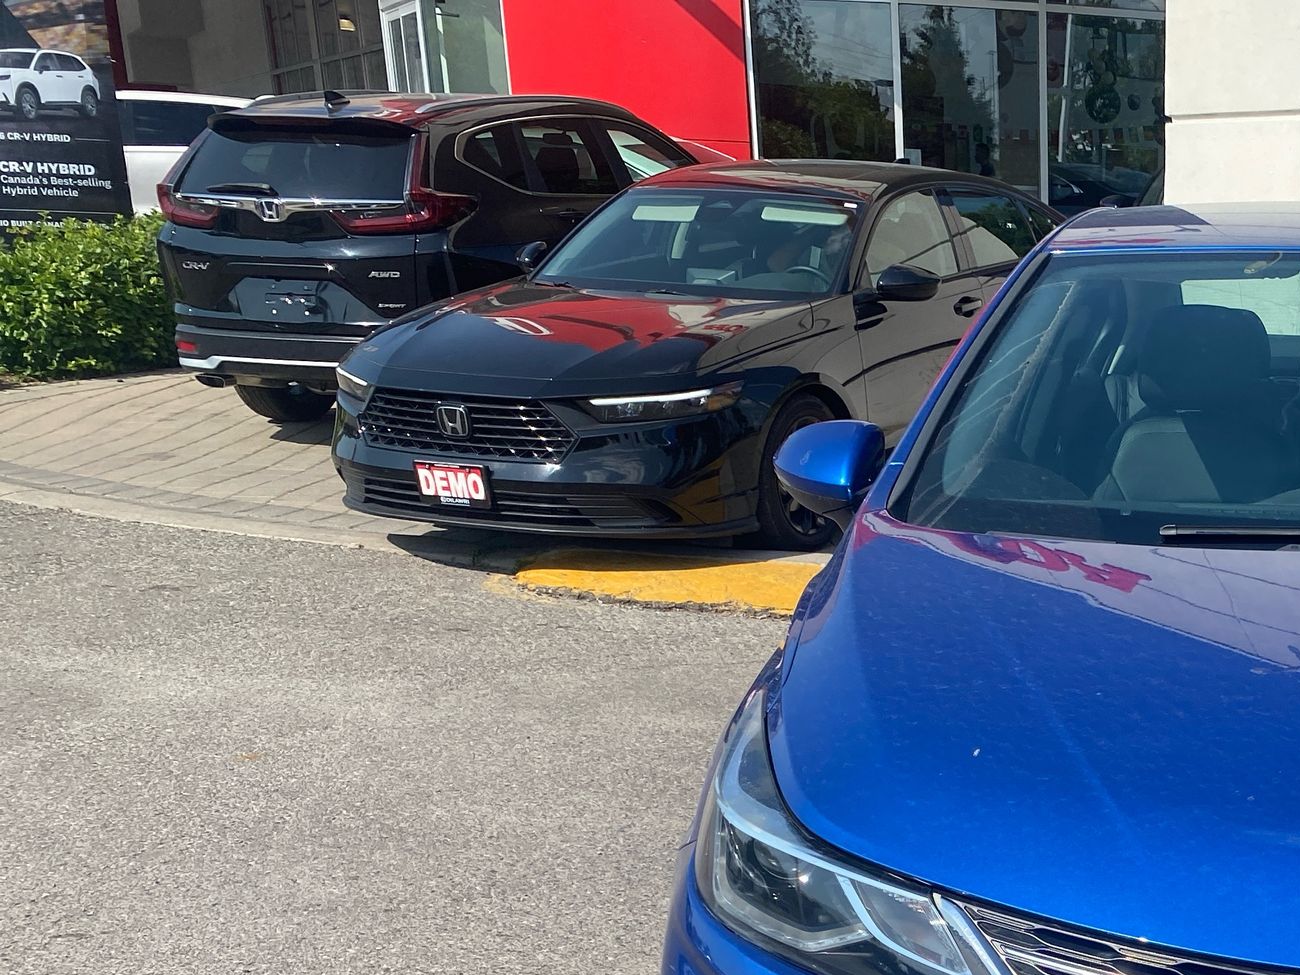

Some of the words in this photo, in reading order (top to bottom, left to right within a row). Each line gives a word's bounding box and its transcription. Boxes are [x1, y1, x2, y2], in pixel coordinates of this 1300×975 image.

[7, 132, 30, 140] CR-V
[33, 133, 71, 142] HYBRID
[0, 161, 33, 173] CR-V
[37, 162, 95, 176] HYBRID
[1, 175, 48, 185] Canada's
[50, 176, 112, 189] Best-selling
[2, 186, 38, 197] Hybrid
[182, 261, 210, 270] CR-V
[368, 270, 401, 278] AWD
[417, 467, 486, 501] DEMO
